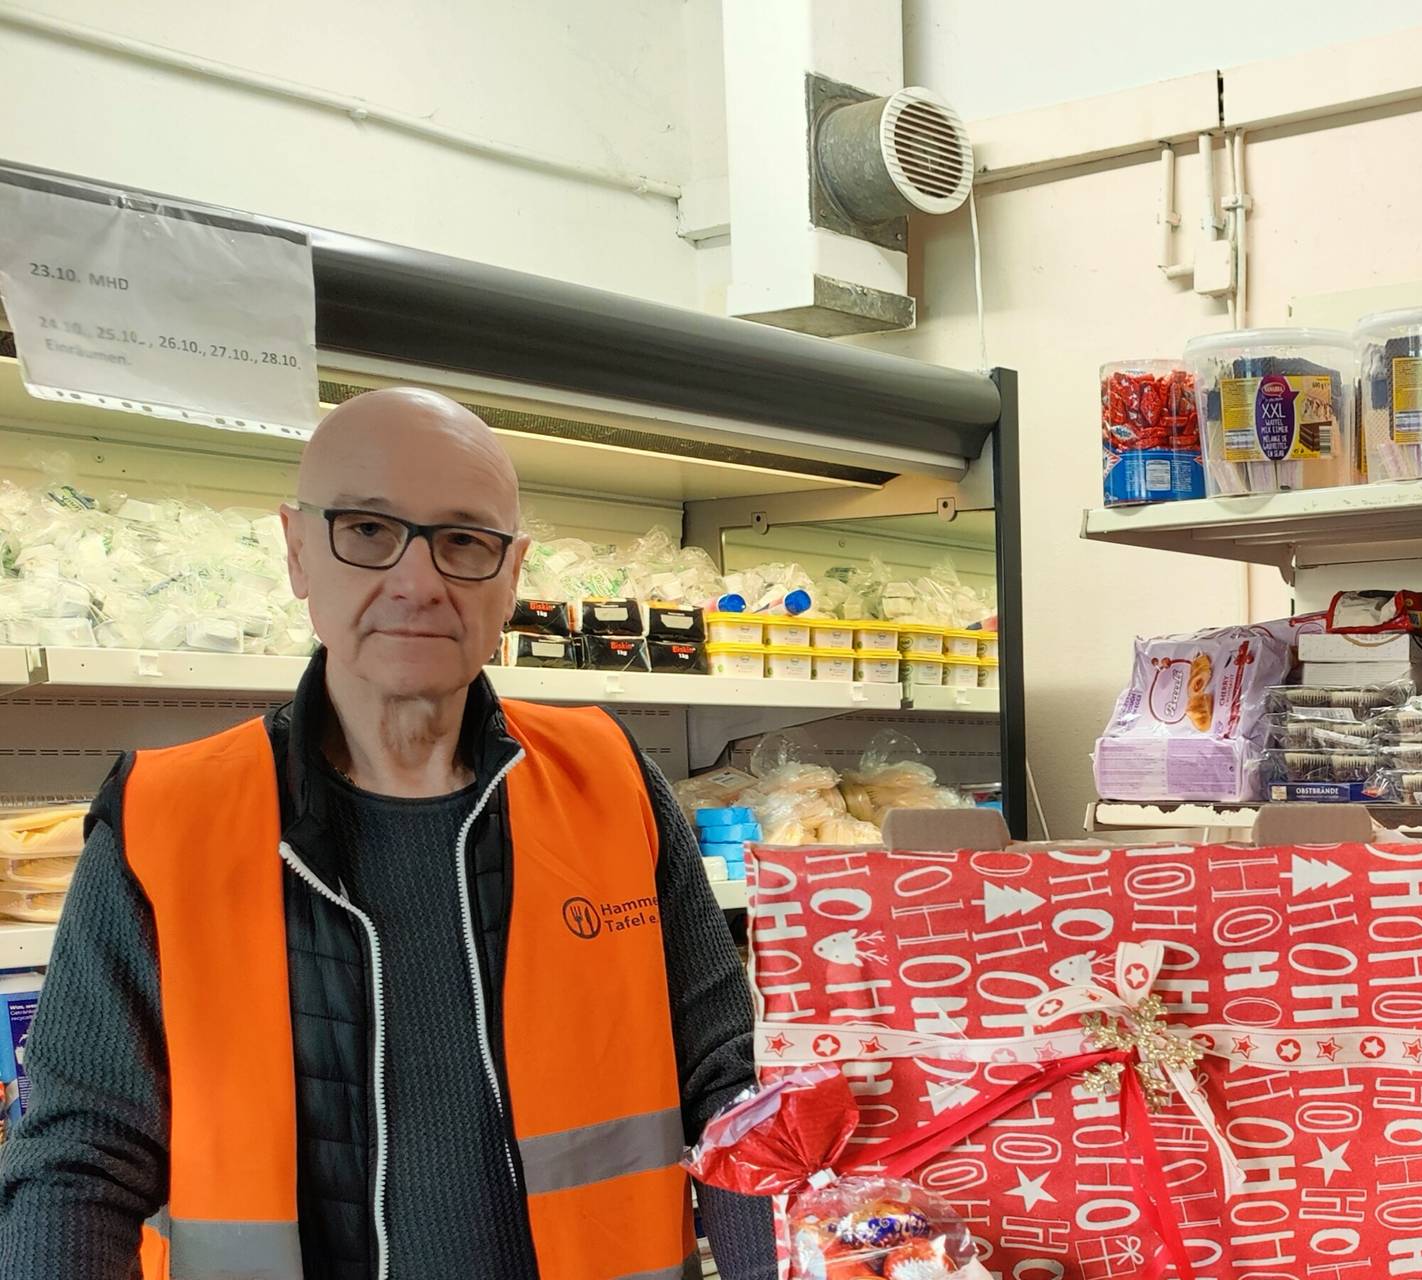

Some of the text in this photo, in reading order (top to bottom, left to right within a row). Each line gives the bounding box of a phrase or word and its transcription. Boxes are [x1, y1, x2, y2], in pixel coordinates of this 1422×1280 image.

[29, 262, 130, 291] 23.10. MHD
[261, 352, 302, 370] 28.10.
[1261, 403, 1286, 418] XXL
[529, 601, 554, 611] Biskin
[610, 641, 634, 650] Biskin
[672, 645, 695, 654] Biskin
[1219, 674, 1230, 707] CHERRY
[1295, 786, 1339, 796] OBSTBRÄNDE
[605, 913, 646, 933] Tafel
